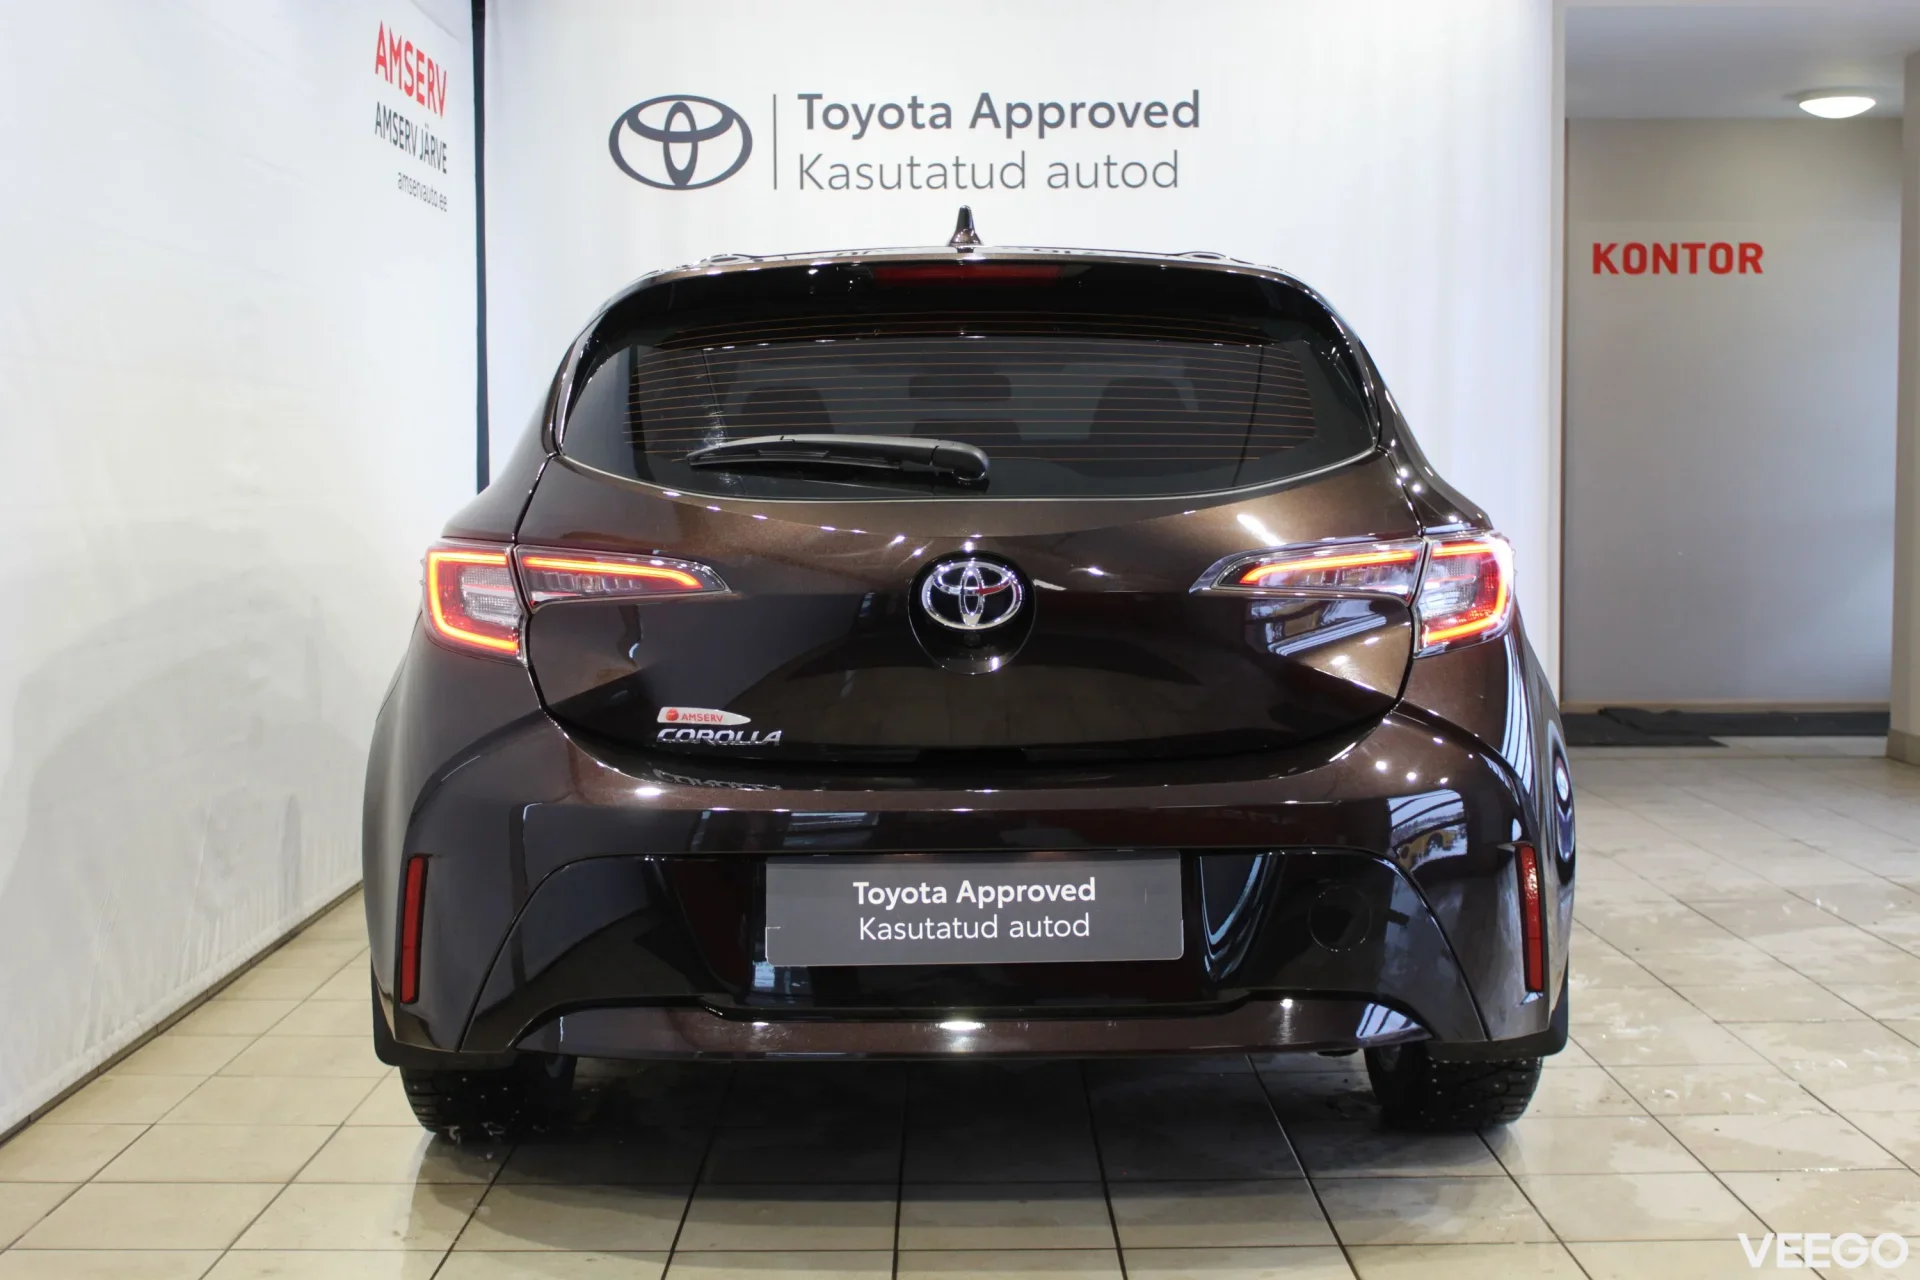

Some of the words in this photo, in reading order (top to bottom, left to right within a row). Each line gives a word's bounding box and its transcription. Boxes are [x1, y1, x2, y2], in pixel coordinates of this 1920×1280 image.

[375, 20, 447, 119] AMSERV
[797, 93, 952, 140] Toyota
[969, 90, 1200, 139] Approved
[375, 101, 418, 156] AMSERV
[419, 122, 447, 174] JÄRVE
[799, 151, 1026, 190] Kasutatud
[1047, 150, 1179, 189] autod
[398, 172, 448, 212] amservauto.ee
[1592, 242, 1764, 275] KONTOR
[681, 713, 723, 722] AMSERV
[657, 728, 782, 745] COROLLA
[853, 881, 947, 910] Toyota
[956, 877, 1096, 909] Approved
[859, 914, 998, 940] Kasutatud
[1009, 912, 1090, 938] autod
